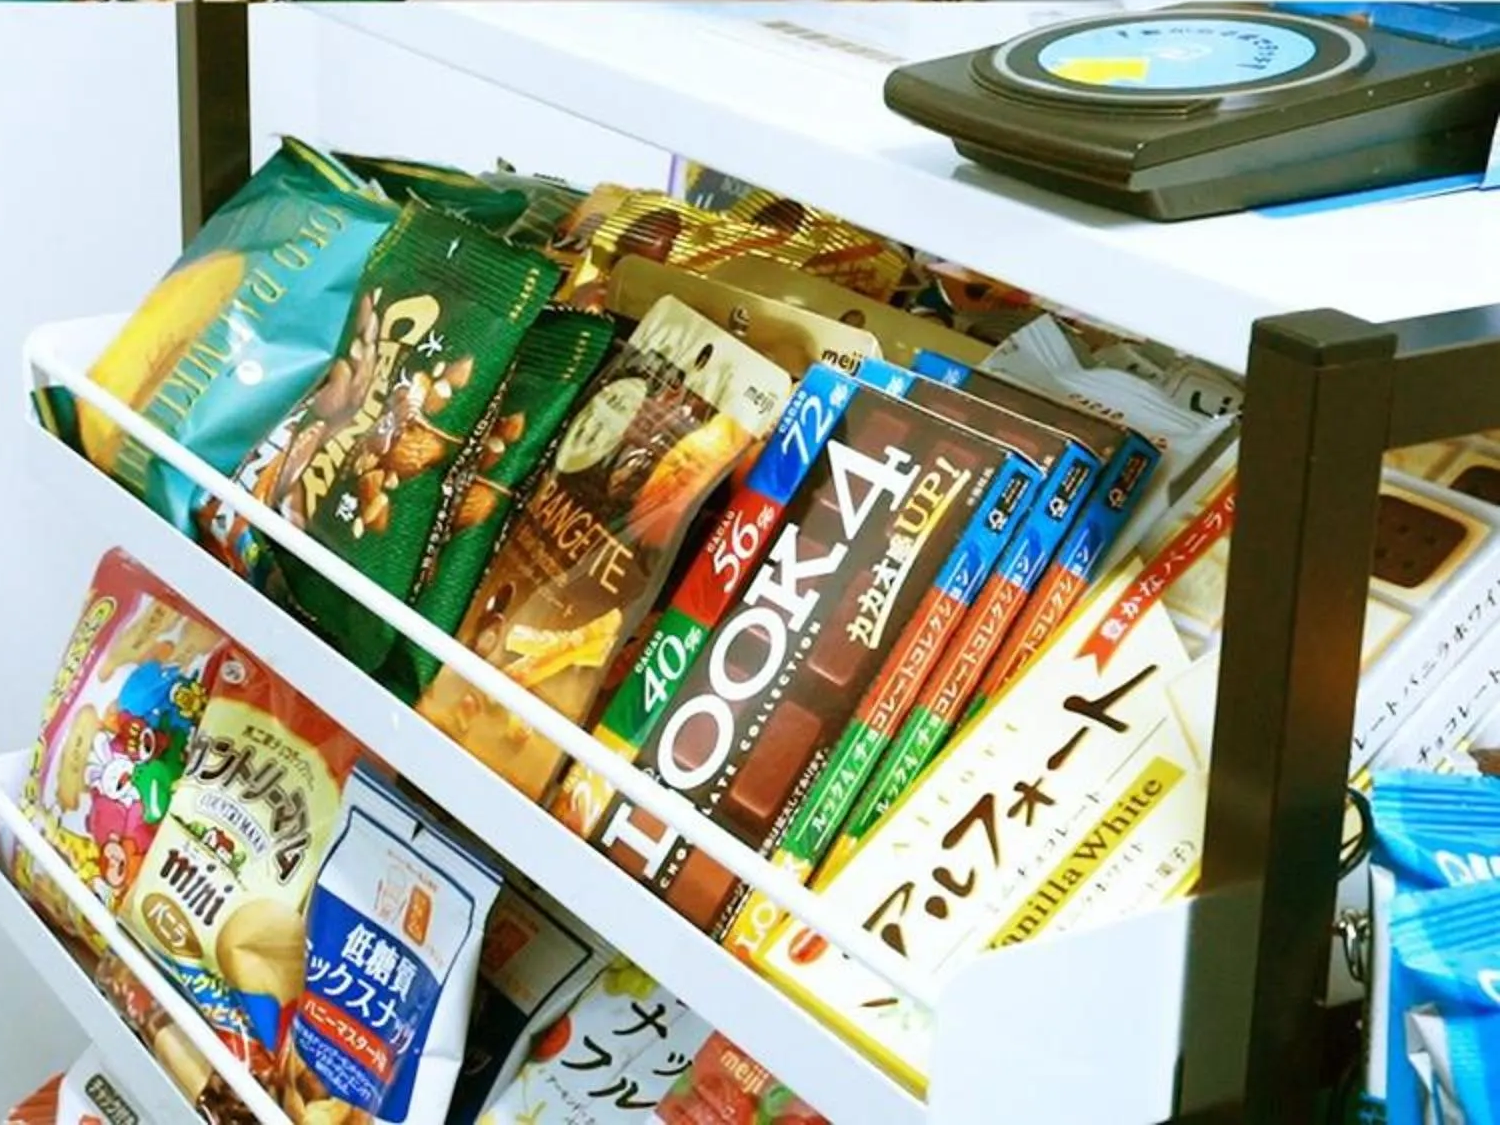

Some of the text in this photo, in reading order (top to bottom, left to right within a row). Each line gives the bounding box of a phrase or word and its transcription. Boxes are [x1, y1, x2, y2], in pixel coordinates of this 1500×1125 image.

[300, 294, 442, 521] CRUNKY
[743, 383, 779, 417] meiji
[826, 439, 922, 541] 4
[861, 662, 1159, 961] アルフォート
[1071, 777, 1164, 864] White
[148, 898, 188, 948] バニラ
[159, 848, 233, 928] mini
[341, 922, 419, 1003] 低糖質
[718, 1049, 770, 1097] meiji
